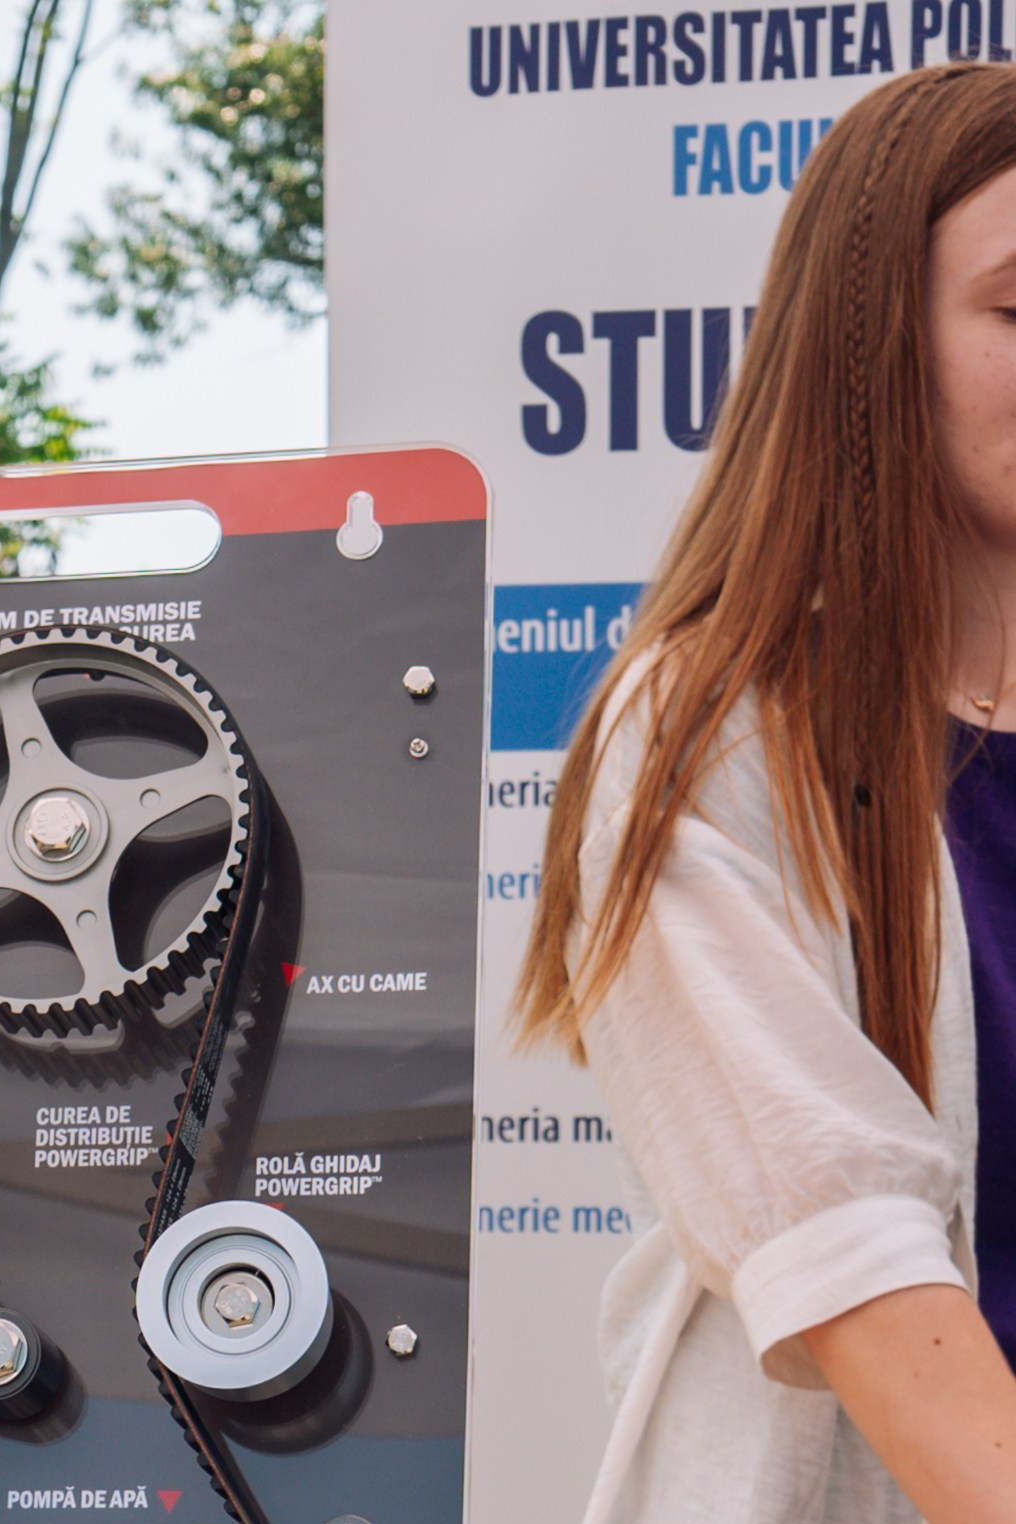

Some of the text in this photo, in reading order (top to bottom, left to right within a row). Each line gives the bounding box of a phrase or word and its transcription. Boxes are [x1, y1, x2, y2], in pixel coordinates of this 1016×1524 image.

[468, 0, 1016, 97] UNIVERSITATEA POL
[673, 117, 834, 197] FACU
[521, 307, 756, 456] STU
[24, 608, 55, 629] DE
[59, 600, 202, 626] TRANSMISIE
[490, 605, 596, 652] eniul
[306, 972, 428, 995] AX CU CAME
[36, 1106, 131, 1126] CUREA DE
[255, 1152, 382, 1175] ROLĂ GHIDAJ
[6, 1485, 148, 1509] POMPĂ DE APĂ
